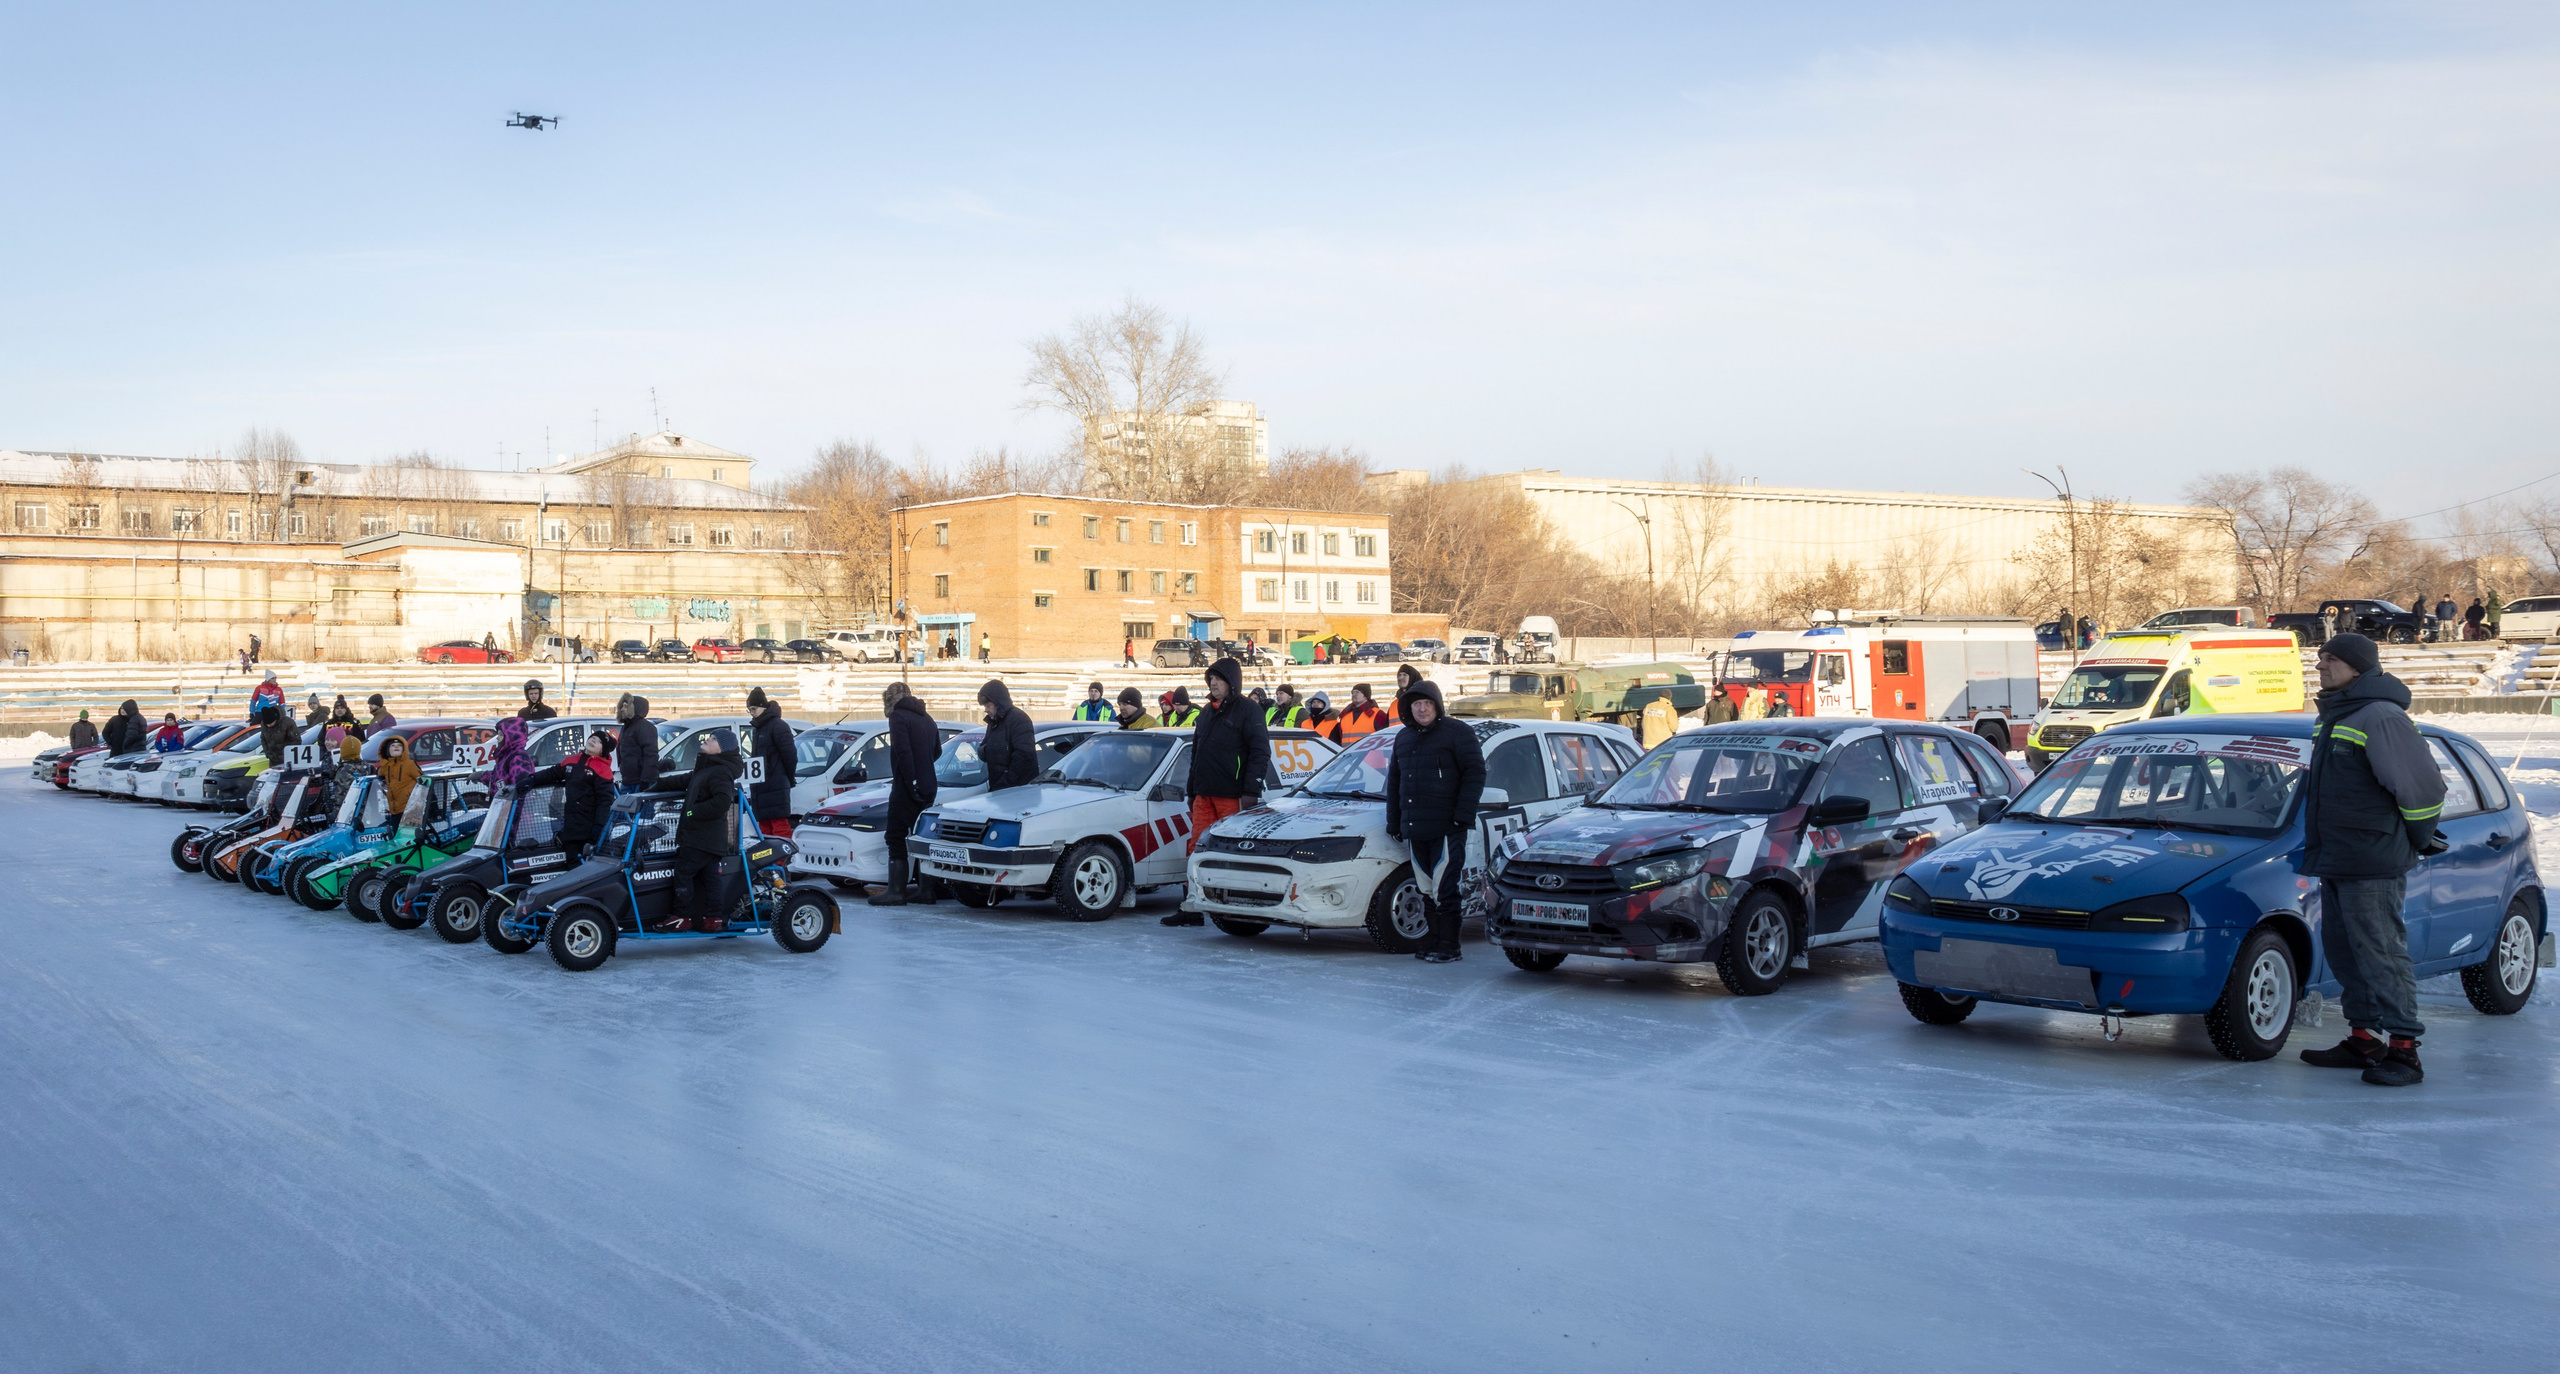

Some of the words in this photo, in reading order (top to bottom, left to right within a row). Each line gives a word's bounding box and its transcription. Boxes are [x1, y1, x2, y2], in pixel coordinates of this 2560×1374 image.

[1819, 695, 1840, 707] УПЧ
[1689, 737, 1766, 745] РАЛЛИ-КРОСС
[291, 746, 313, 764] 14
[1274, 739, 1314, 773] 55
[2071, 743, 2169, 760] GTservice
[1567, 741, 1585, 780] 7
[1923, 742, 1945, 783] 5
[1920, 786, 1958, 800] Агарков
[531, 853, 564, 863] ГРИГОРЬЕВ
[930, 849, 957, 859] РУБЦОВСК
[958, 850, 966, 859] 22
[1513, 903, 1557, 918] РАЛЛИ-КРОСС
[1559, 906, 1587, 922] РОССИИ
